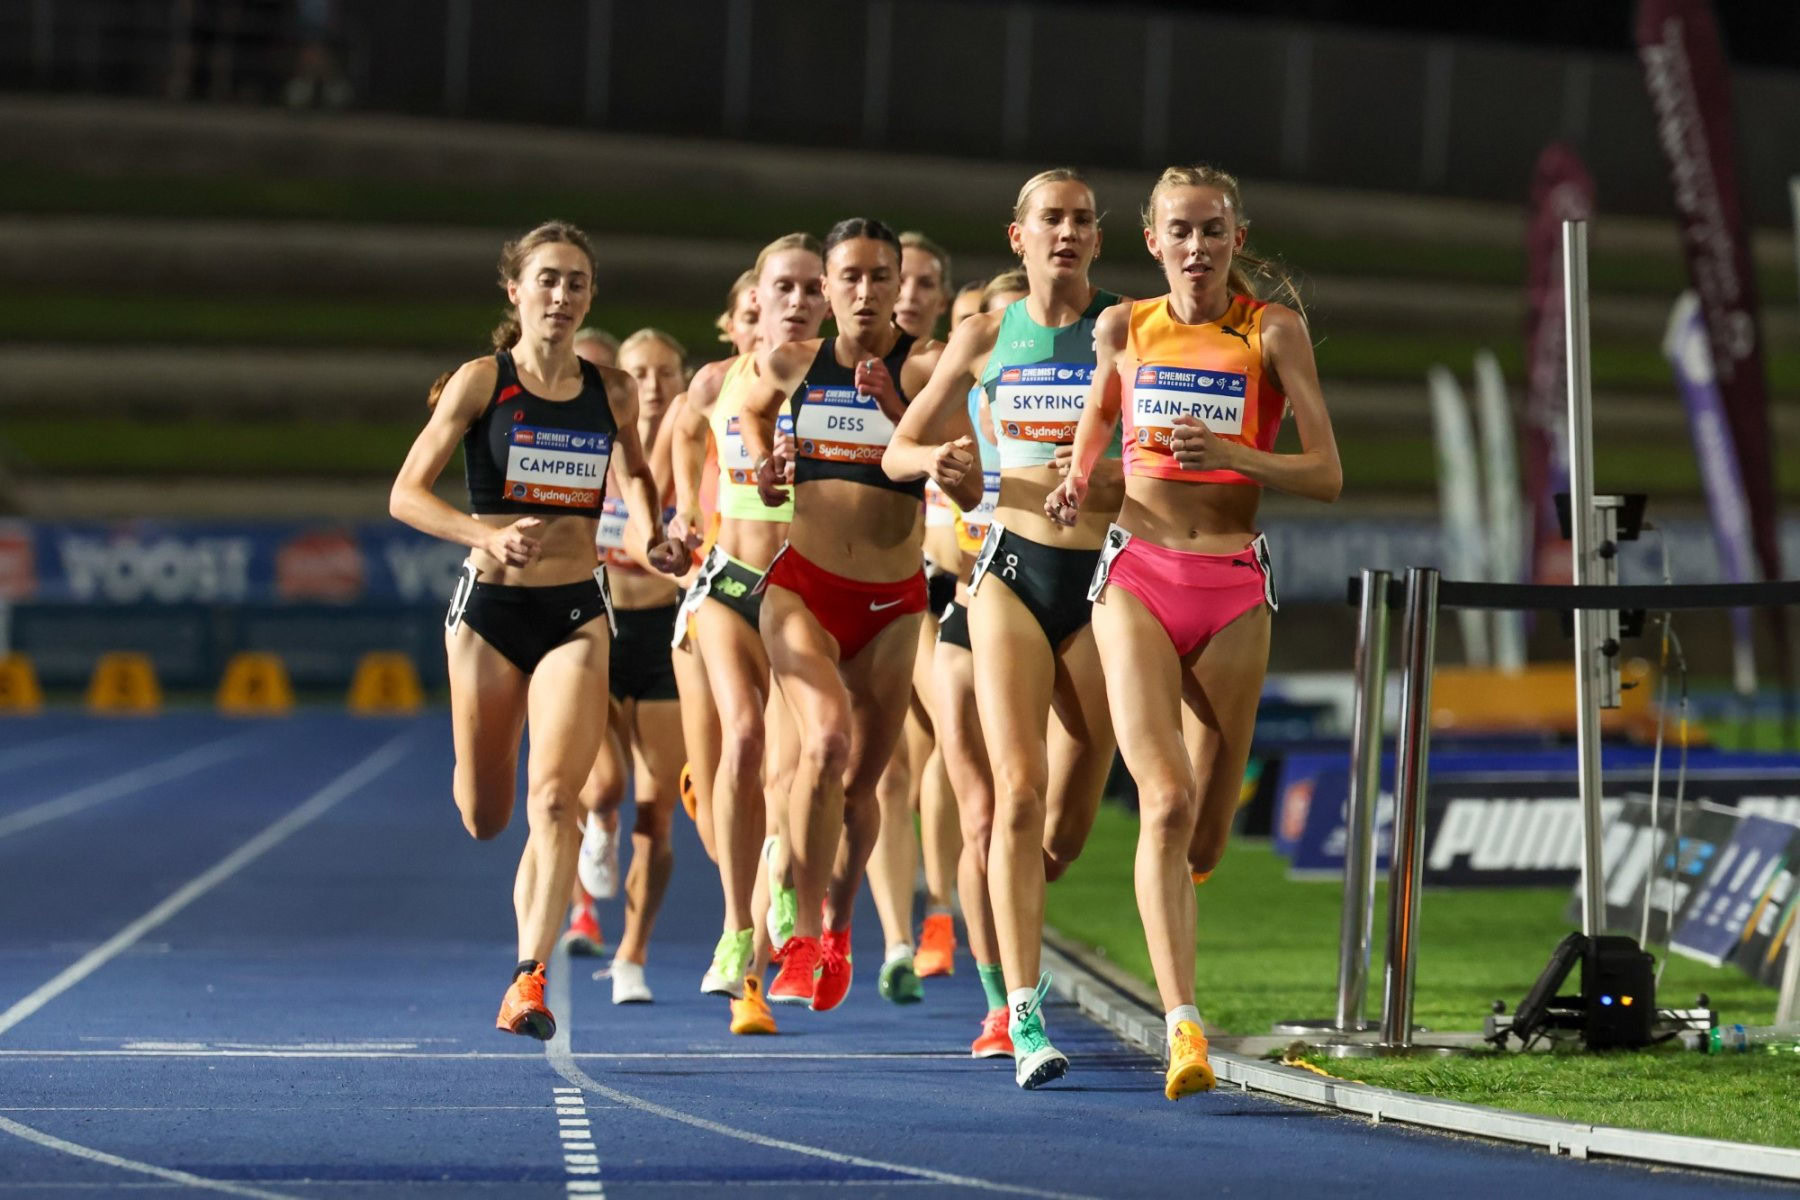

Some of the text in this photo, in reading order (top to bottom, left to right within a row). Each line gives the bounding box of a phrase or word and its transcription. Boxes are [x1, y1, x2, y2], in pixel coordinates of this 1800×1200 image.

[1158, 371, 1196, 382] CHEMIST
[1013, 395, 1084, 409] SKYRING
[1136, 399, 1238, 422] FEAIN-RYAN
[827, 415, 864, 432] DESS
[520, 457, 597, 477] CAMPBELL
